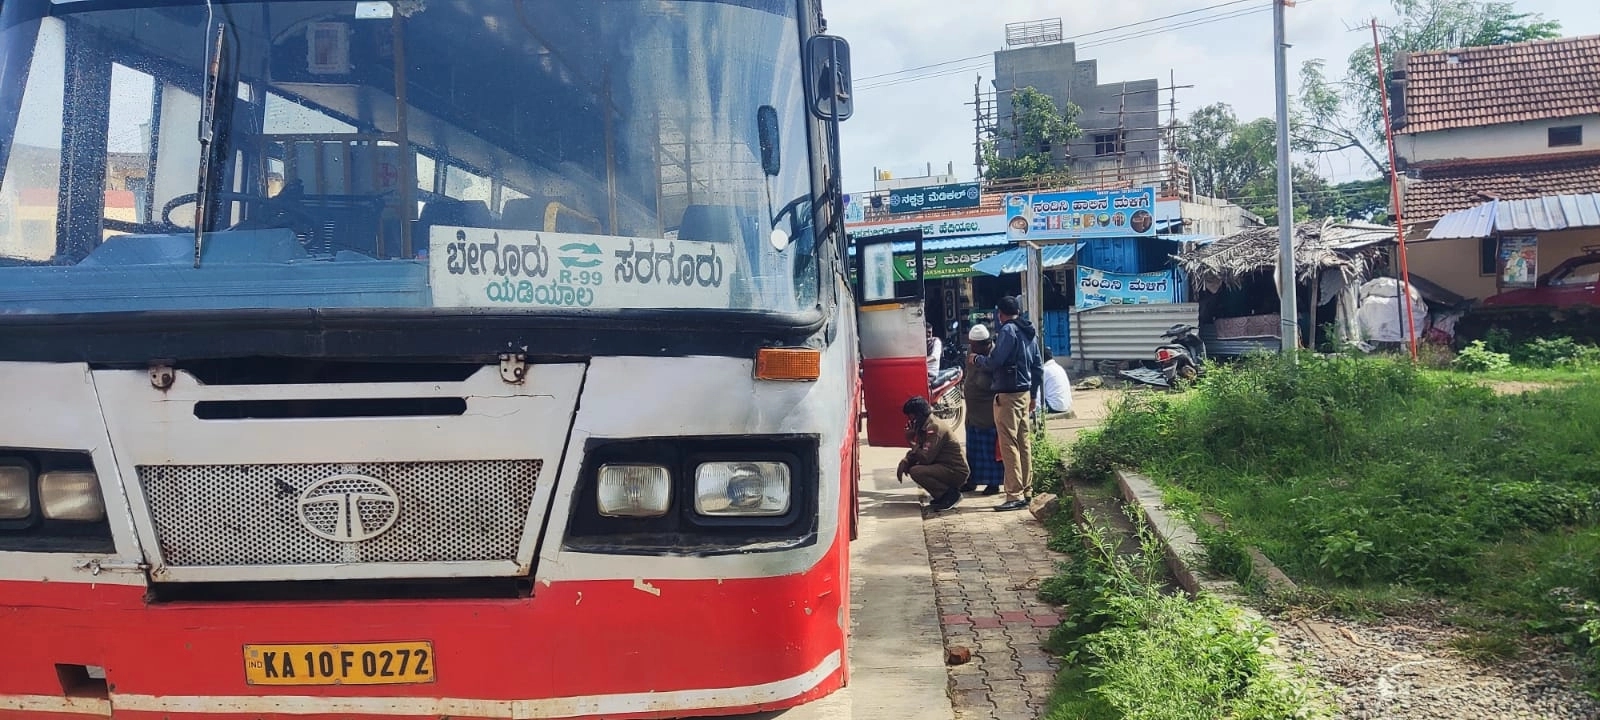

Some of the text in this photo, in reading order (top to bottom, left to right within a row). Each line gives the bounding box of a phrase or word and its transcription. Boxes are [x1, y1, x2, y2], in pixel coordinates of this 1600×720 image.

[901, 189, 966, 207] ನಕ್ಷತ್ರ ಮೆಡಿಕಲ್
[1033, 192, 1150, 212] ನಂದಿನಿ ಹಾಲಿನ ಮಳಿಗೆ
[446, 229, 724, 288] ಬೇಗೂರು ಸರಗೂರು
[559, 269, 603, 286] R-99
[1081, 277, 1167, 292] ನಂದಿನಿ ಮಳಿಗೆ
[486, 275, 594, 307] ಯಡಿಯಾಲ
[248, 661, 263, 669] IND
[263, 649, 429, 678] KA 10 F 0272
